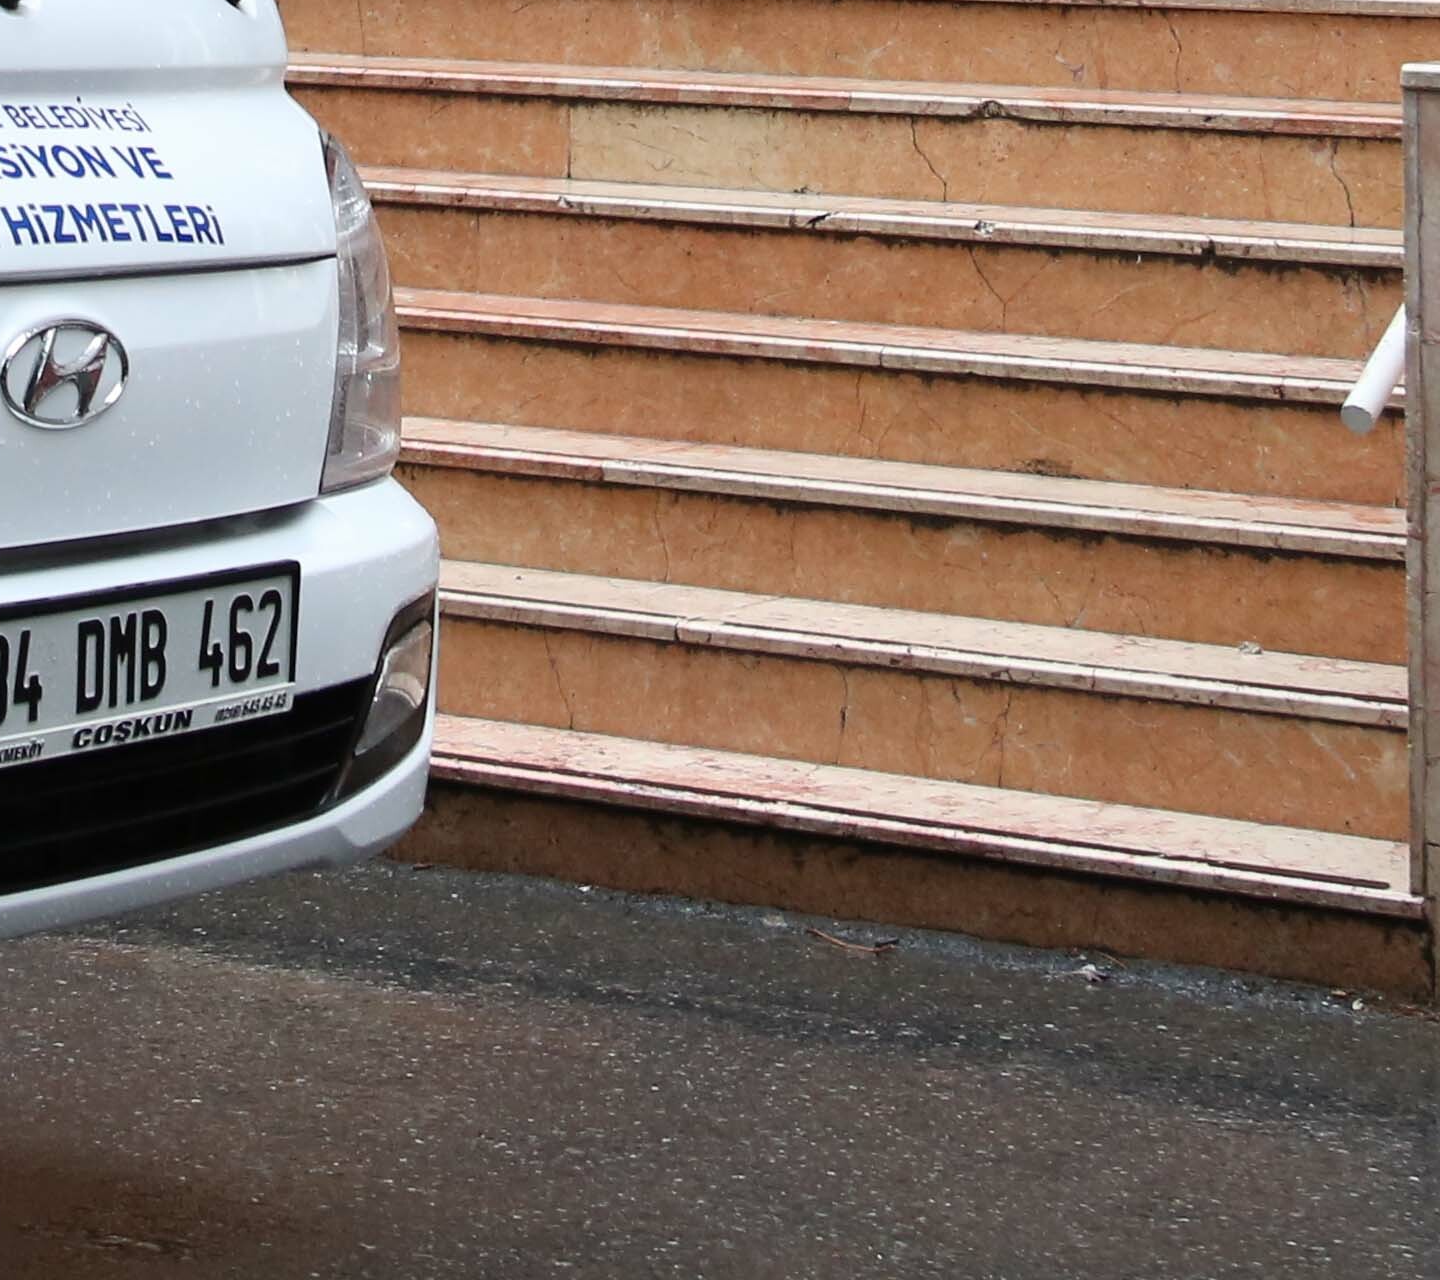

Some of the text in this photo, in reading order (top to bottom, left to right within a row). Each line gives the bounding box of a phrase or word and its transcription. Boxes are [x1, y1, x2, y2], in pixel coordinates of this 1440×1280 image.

[3, 96, 152, 133] BELEDİYESİ
[116, 146, 173, 179] VE
[1, 203, 225, 246] HİZMETLERİ
[77, 609, 168, 715] DMB
[199, 588, 283, 688] 462
